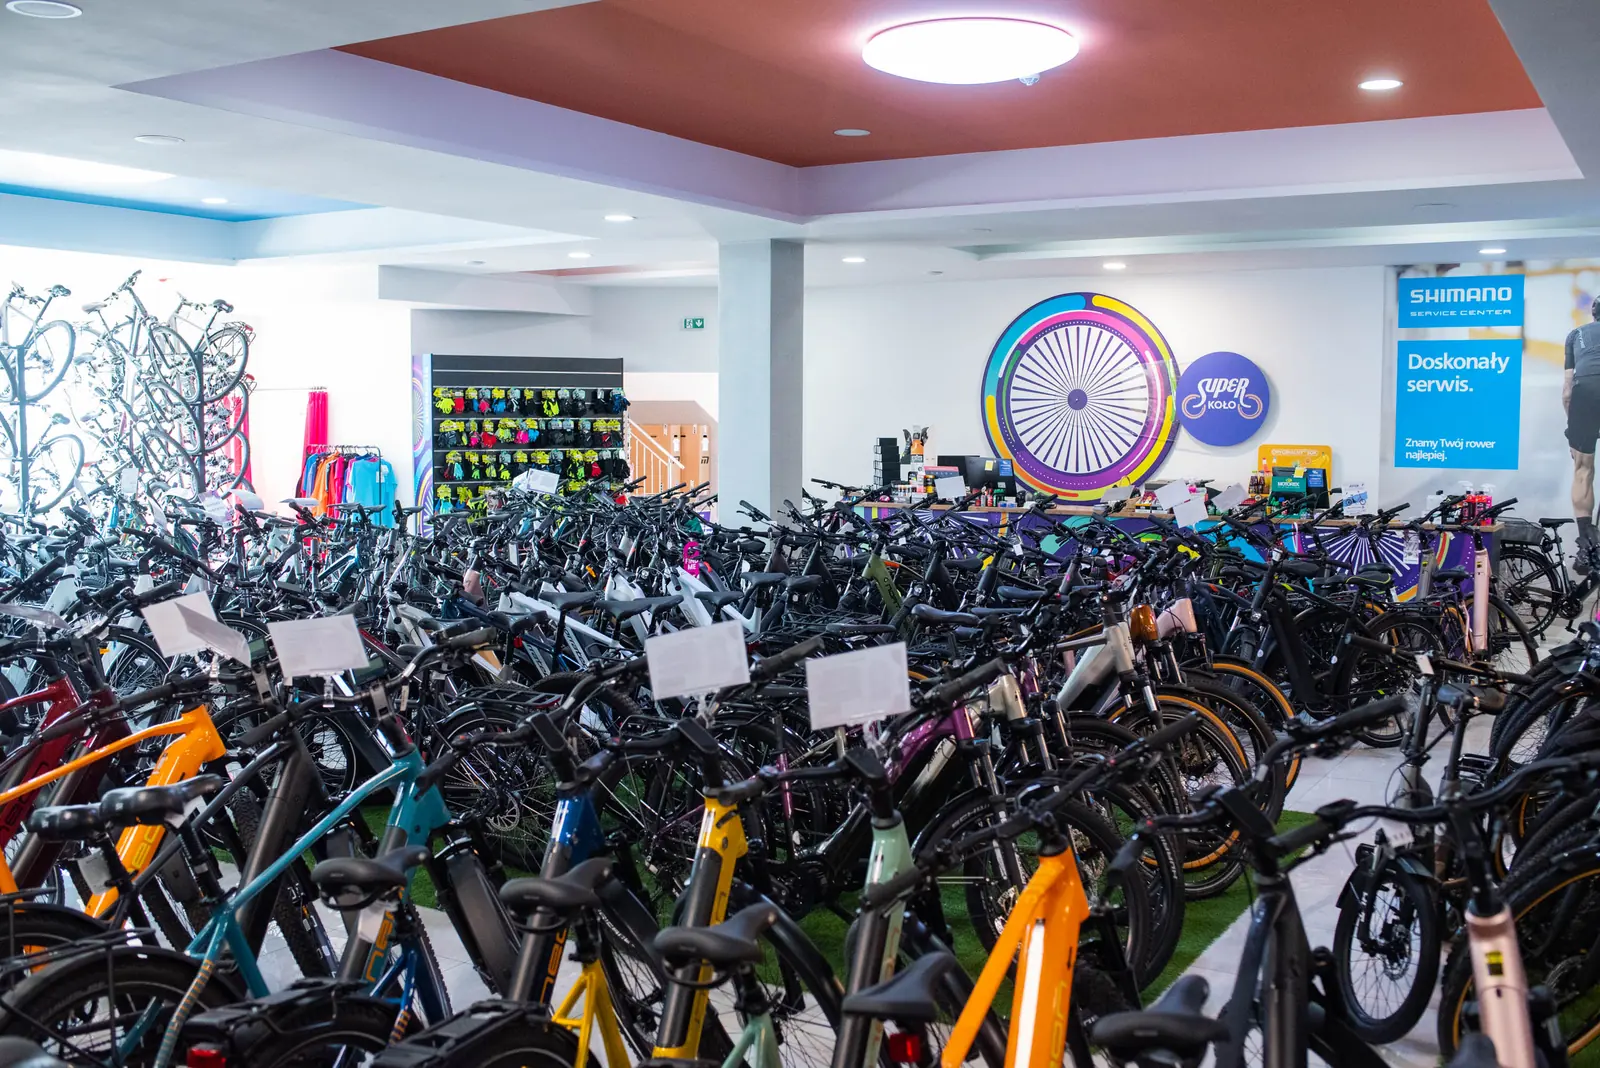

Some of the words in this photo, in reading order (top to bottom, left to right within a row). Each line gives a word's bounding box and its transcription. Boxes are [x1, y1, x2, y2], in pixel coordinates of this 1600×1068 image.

[1410, 286, 1512, 304] SHIMANO
[1408, 352, 1510, 374] Doskonały
[1407, 375, 1474, 392] serwis.
[1207, 400, 1237, 410] KOŁO
[1405, 438, 1438, 450] Znamy
[1439, 438, 1464, 450] Twój
[1465, 440, 1496, 449] rower
[1405, 450, 1447, 462] najlepiej.
